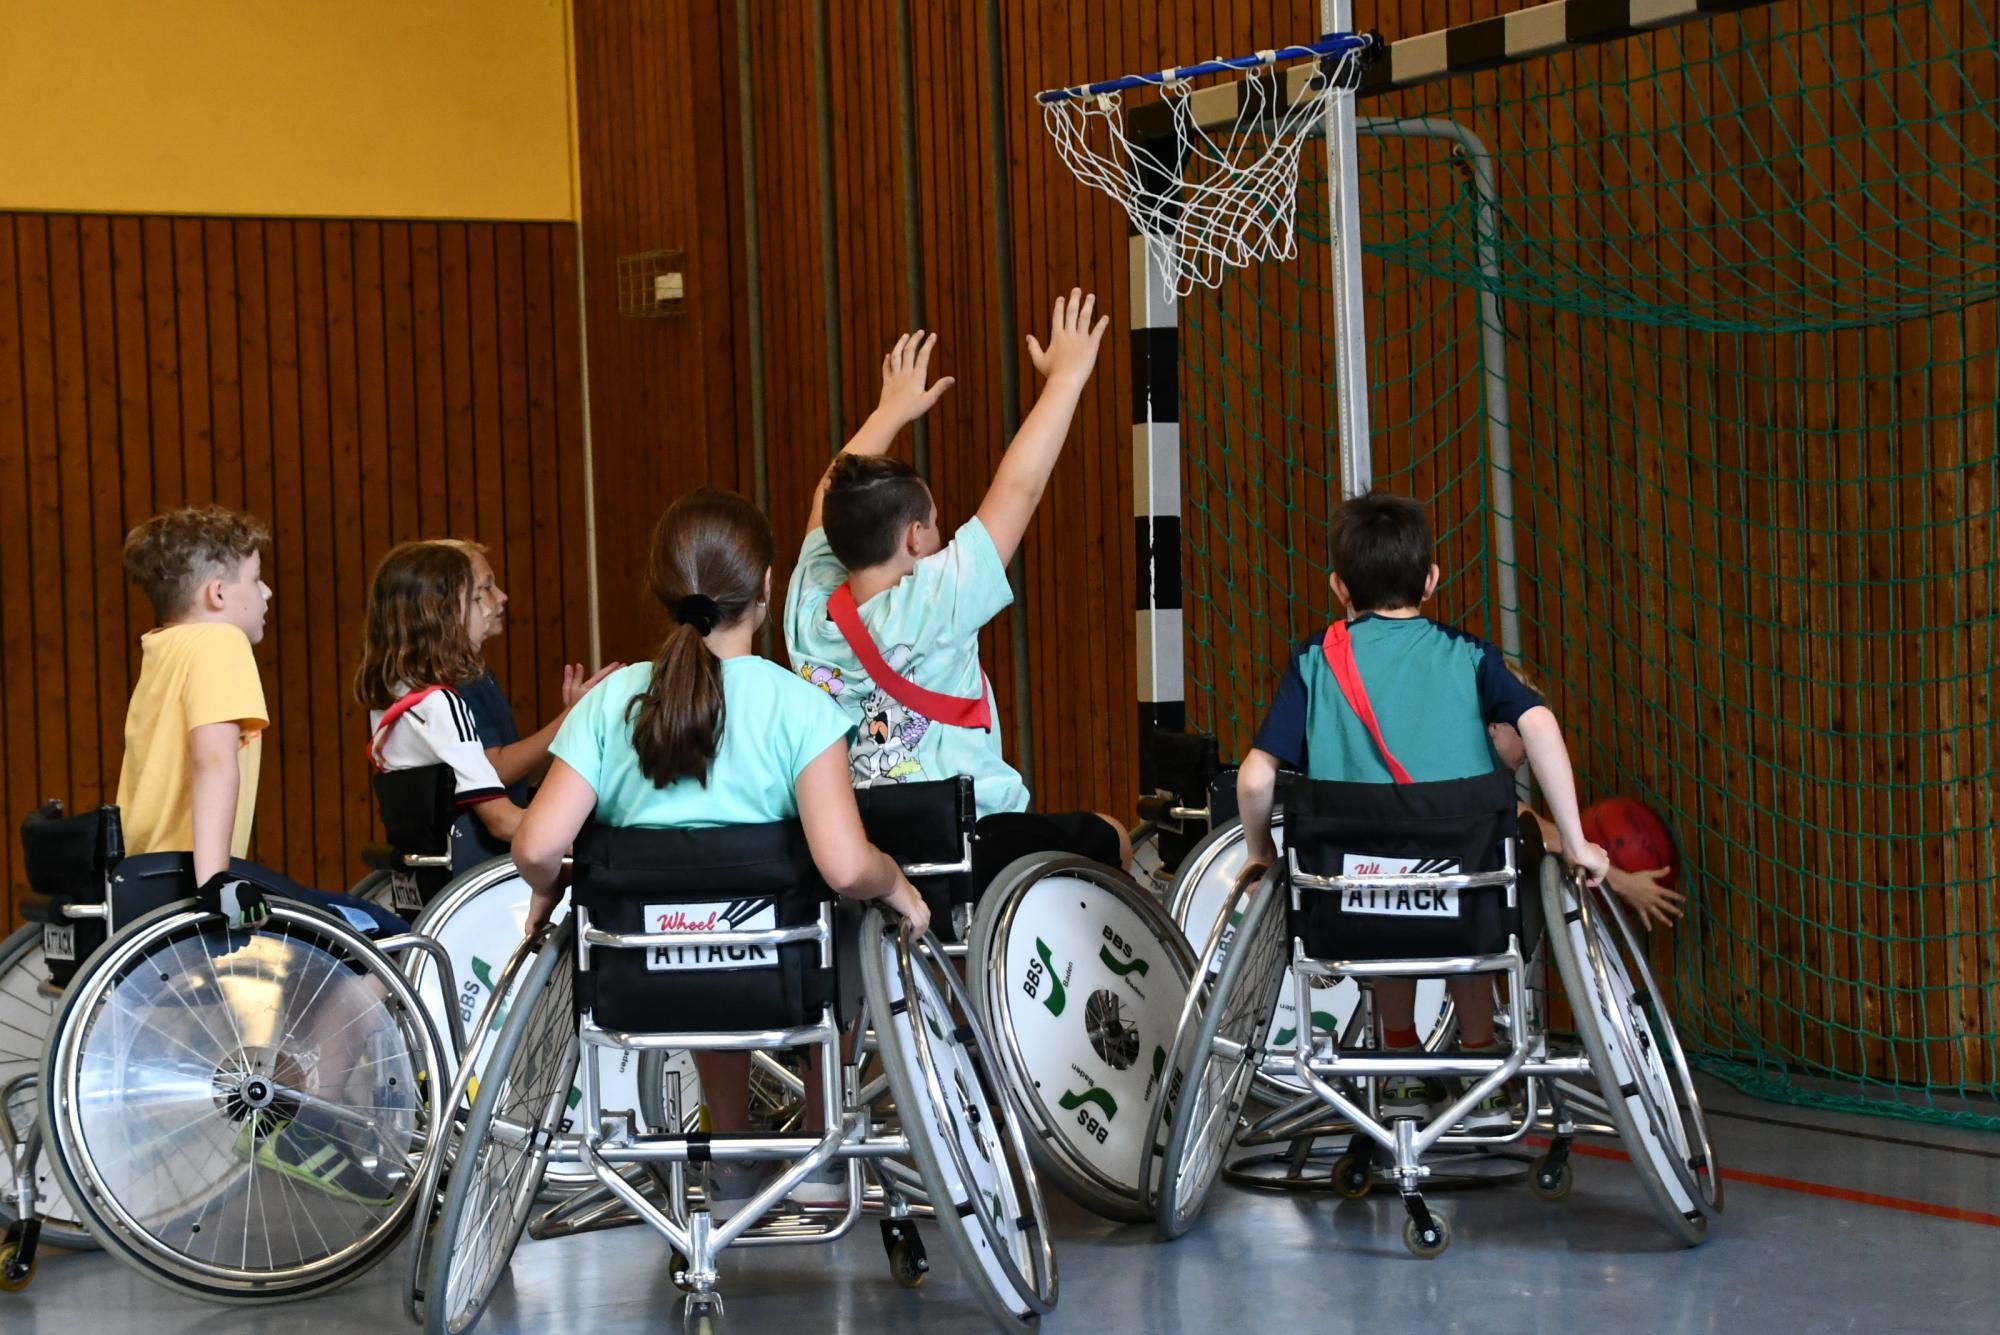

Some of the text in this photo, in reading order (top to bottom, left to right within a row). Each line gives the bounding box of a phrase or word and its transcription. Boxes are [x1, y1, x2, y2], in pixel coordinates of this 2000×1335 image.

[1348, 889, 1448, 911] ATTACK
[657, 911, 717, 930] Wheel
[655, 944, 767, 964] ATTACK
[1102, 925, 1133, 958] BBS
[1023, 958, 1043, 1000] BBS
[1063, 961, 1073, 988] Baden
[1072, 1063, 1095, 1087] Baden
[1077, 1109, 1109, 1144] BBS
